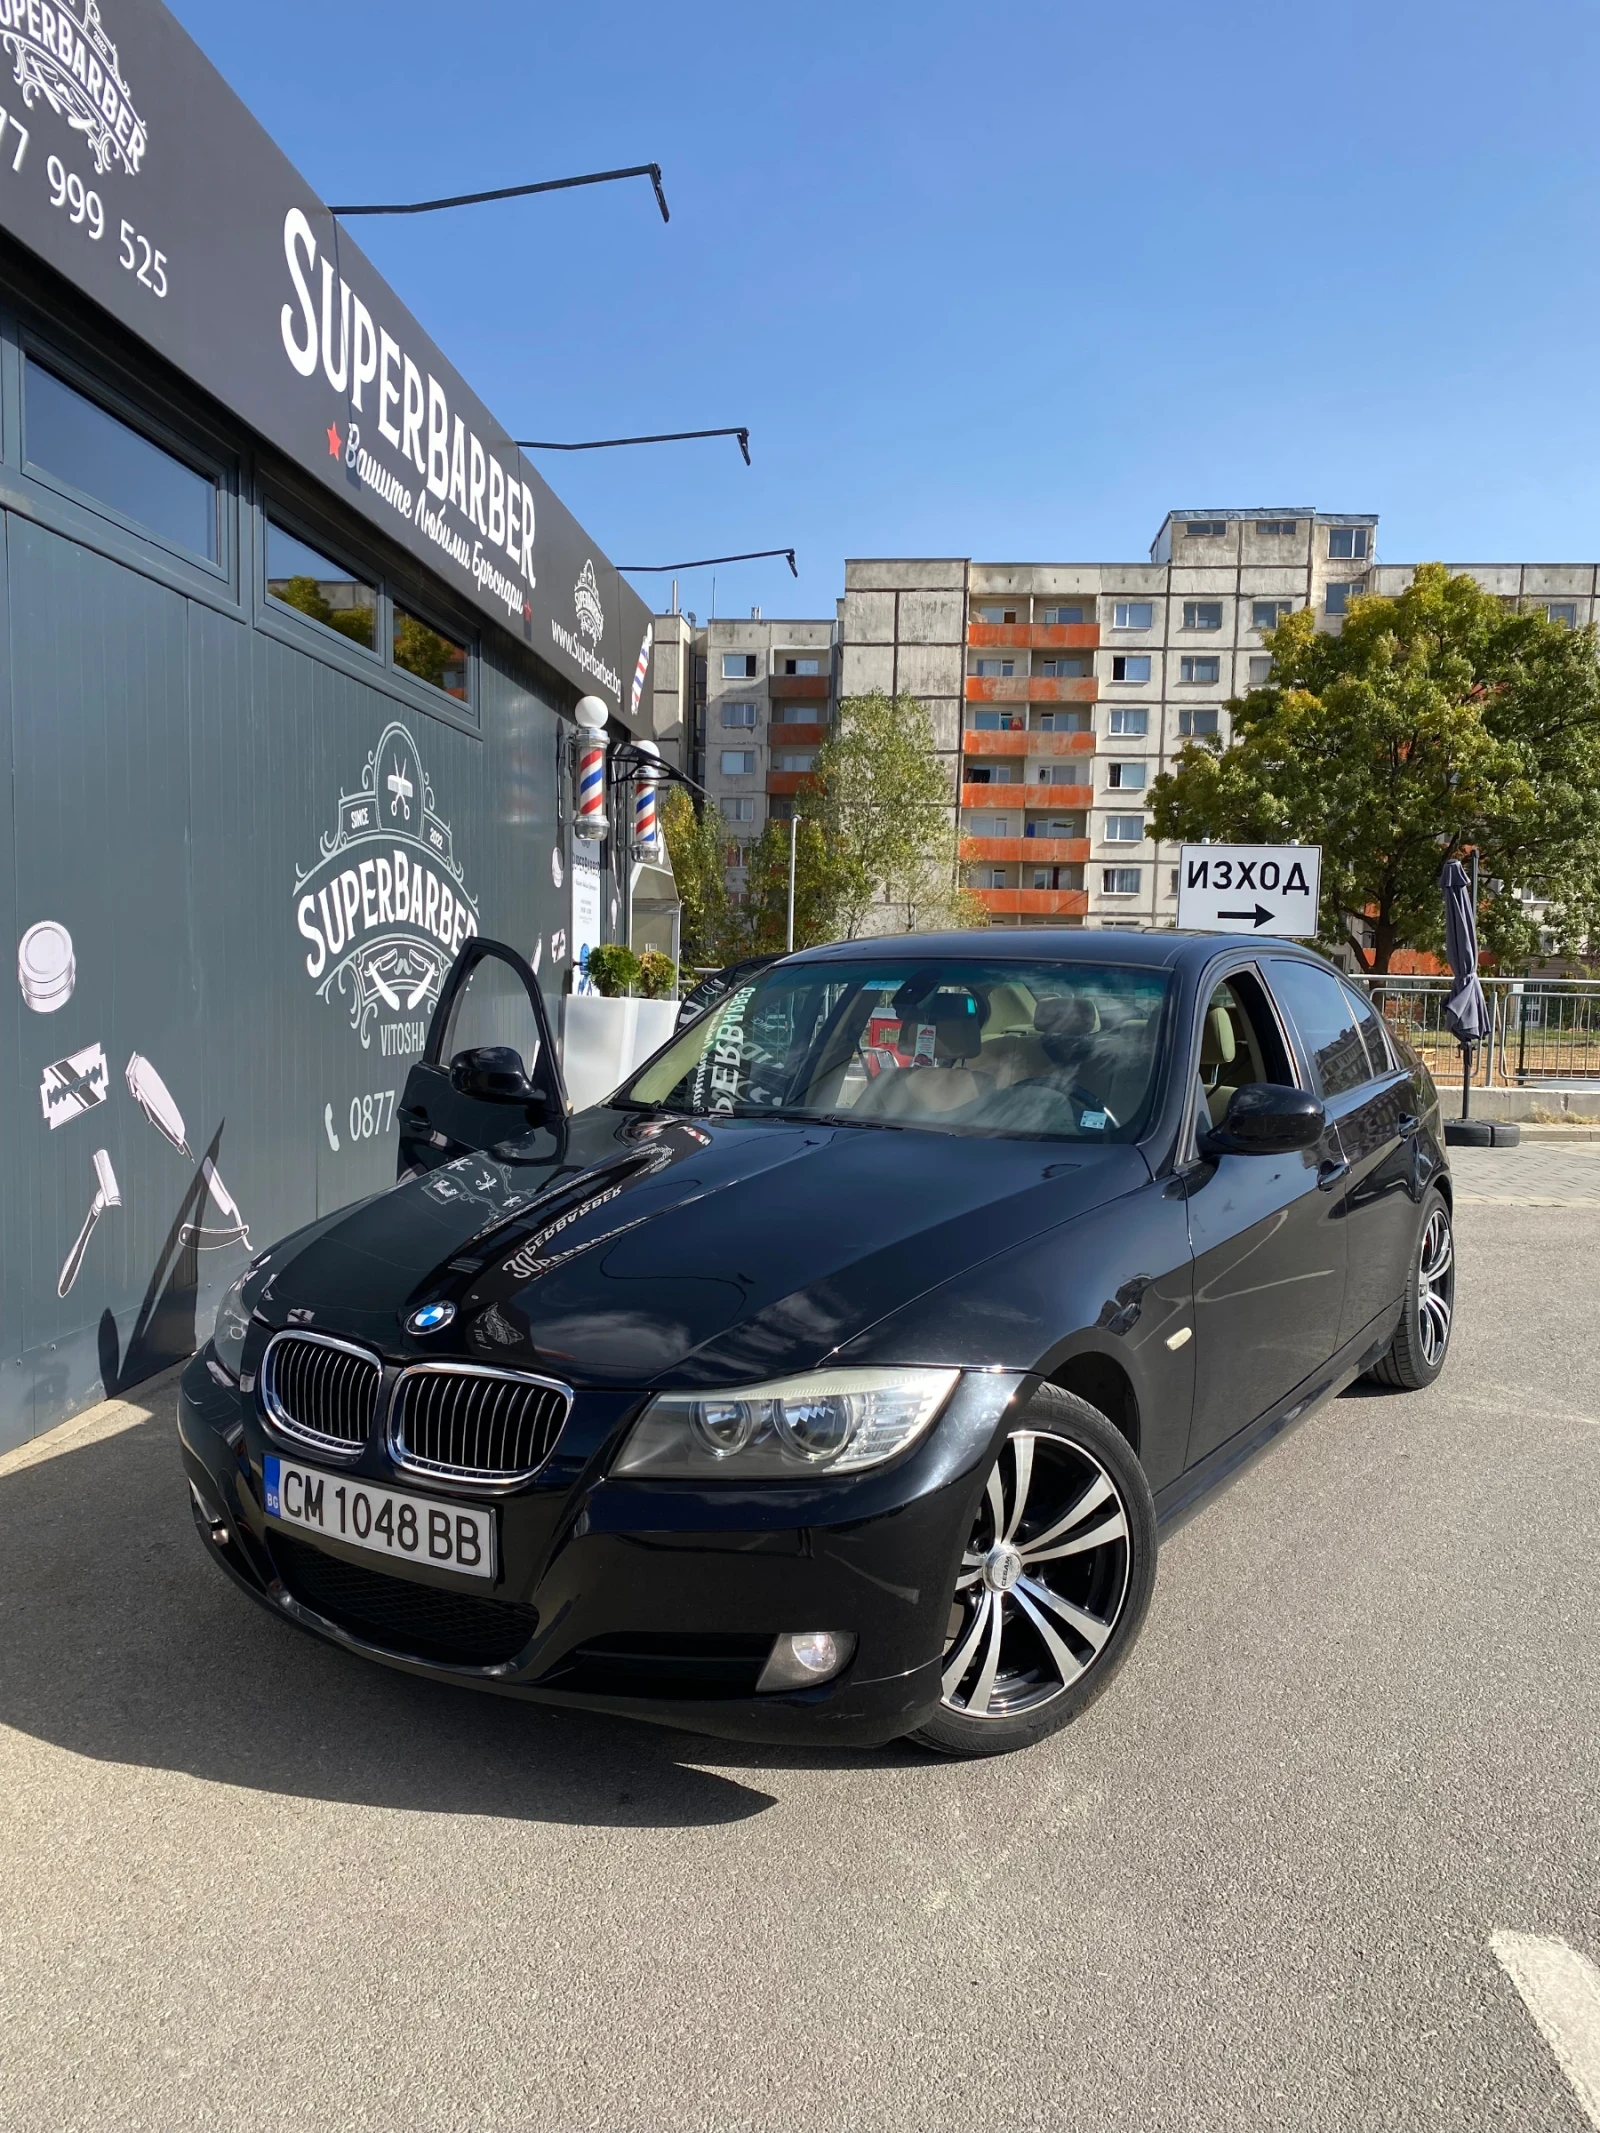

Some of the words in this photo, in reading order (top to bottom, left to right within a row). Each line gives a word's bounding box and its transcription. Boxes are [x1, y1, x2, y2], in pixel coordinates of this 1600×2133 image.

[47, 155, 104, 240] 999
[119, 219, 168, 298] 525
[345, 422, 413, 519] Вашите
[414, 489, 470, 570] Любими
[472, 540, 524, 617] Бръснари
[551, 618, 622, 704] www.Superbarber.bg
[350, 807, 370, 829] SINCE
[429, 826, 443, 850] 2022
[1187, 860, 1310, 896] ИЗХОД
[380, 1021, 425, 1057] VITOSHA
[349, 1089, 395, 1143] 0877
[266, 1493, 279, 1509] BG
[284, 1470, 324, 1527] CM
[335, 1486, 419, 1551] 1048
[428, 1509, 482, 1567] BB
